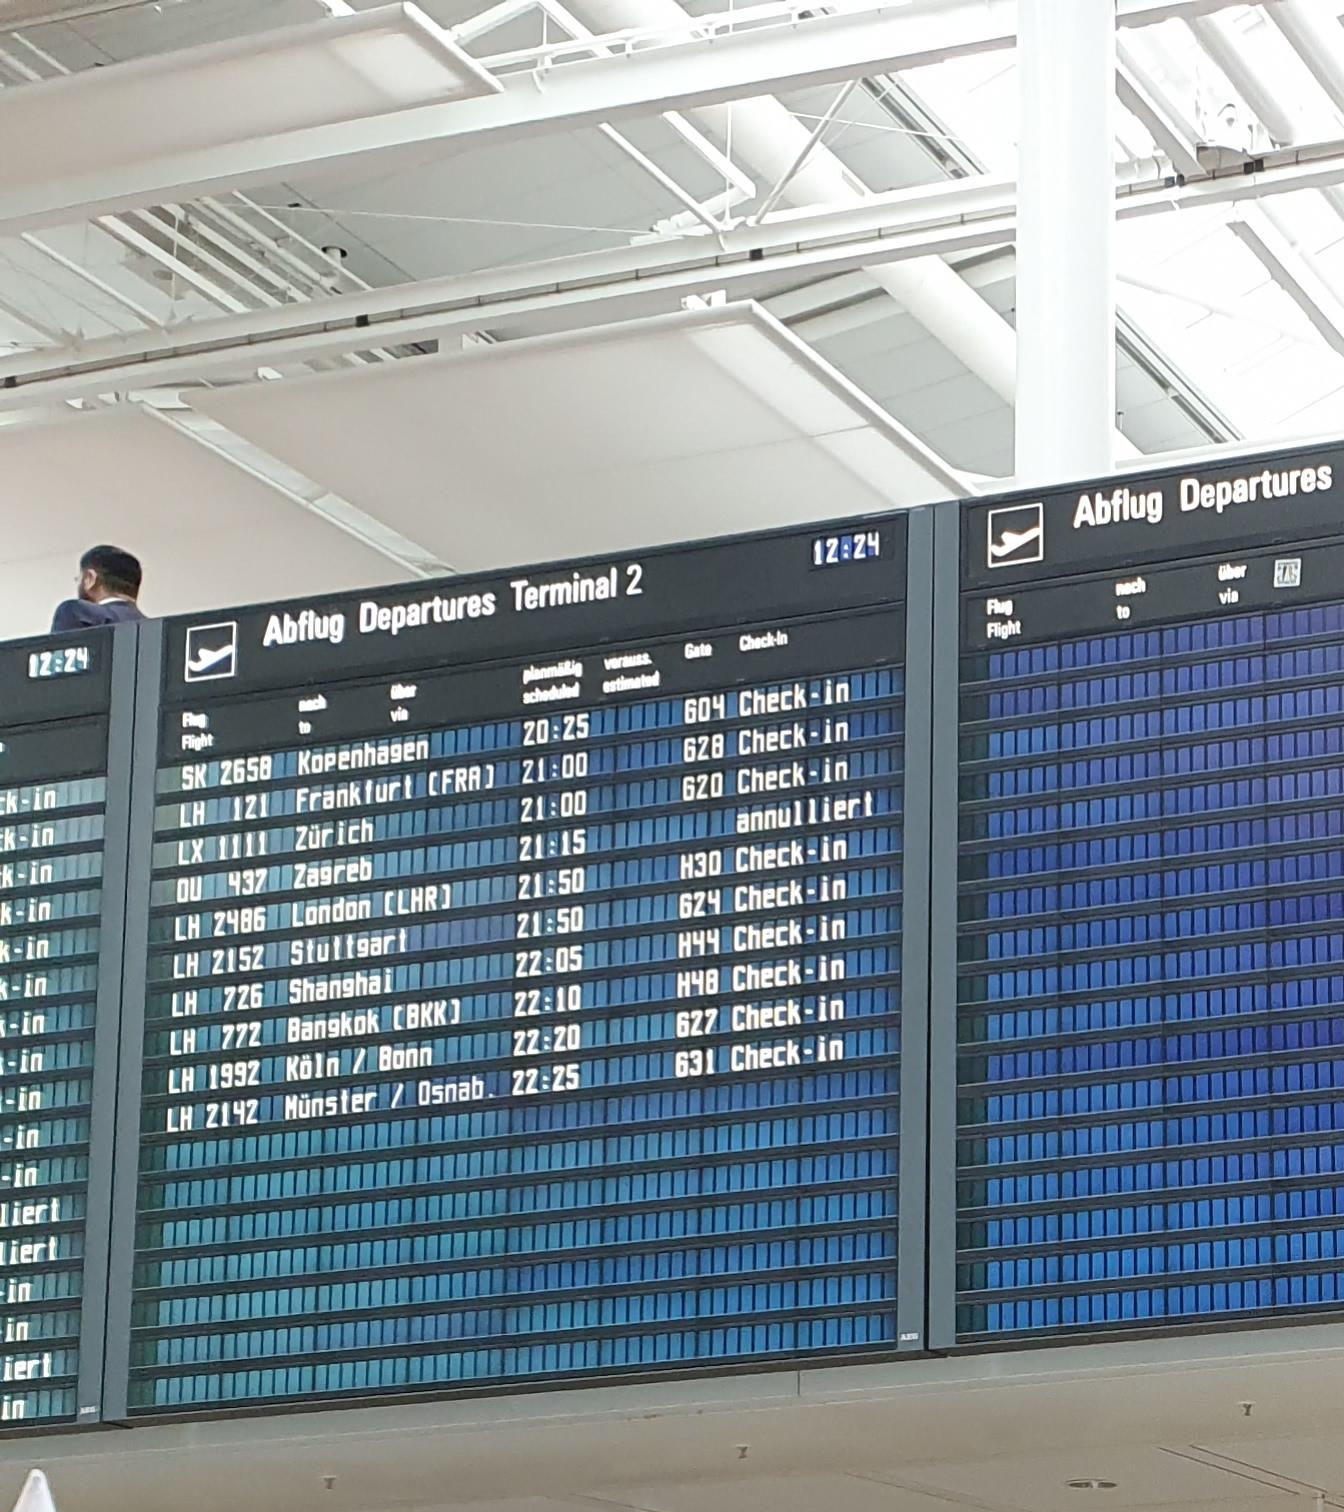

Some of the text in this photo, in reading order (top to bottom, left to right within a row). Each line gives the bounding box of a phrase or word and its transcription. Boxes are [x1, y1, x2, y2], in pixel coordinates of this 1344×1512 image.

[1074, 488, 1162, 528] Abflug
[1181, 466, 1332, 513] Departures
[815, 532, 879, 564] 12:24
[263, 564, 642, 646] Abflug Departures Terminal 2
[987, 620, 1021, 639] Flight
[29, 648, 88, 678] 12:24
[180, 802, 204, 827] LH
[234, 794, 267, 820] 121
[296, 776, 411, 812] Frankfurt
[523, 753, 587, 783] 21:00
[739, 720, 847, 754] Check-in
[182, 764, 206, 790] SK
[221, 756, 271, 785] 2658
[299, 741, 428, 775] Kopenhagen
[524, 714, 588, 745] 20:25
[740, 680, 848, 716] Check-in
[182, 733, 213, 750] Flight
[177, 792, 871, 902] OU 437 Zagreb 21:15 annulliert
[179, 839, 203, 865] LX
[220, 832, 265, 859] 1111
[296, 819, 372, 850] Zürich
[522, 791, 586, 821] 21:00
[738, 759, 847, 793] Check-in
[174, 953, 198, 978] LH
[213, 946, 263, 974] 2152
[291, 929, 405, 965] Stuttgart
[518, 907, 582, 938] 21:50
[735, 877, 845, 911] Check-in
[176, 915, 199, 940] LH
[214, 907, 265, 936] 2486
[293, 898, 370, 927] London
[519, 868, 584, 899] 21:50
[681, 851, 720, 879] H30
[736, 837, 846, 872] Check-in
[171, 1029, 195, 1055] LH
[223, 1022, 260, 1049] 772
[288, 1010, 379, 1042] Bangkok
[515, 985, 580, 1016] 22:10
[678, 969, 718, 997] H48
[733, 956, 844, 991] Check-in
[173, 916, 844, 1016] LH 726 Shanghai 22:05 H44 Check-in
[168, 1107, 192, 1132] LH
[207, 1100, 257, 1128] 2142
[286, 1090, 376, 1119] Münster
[419, 1076, 492, 1105] Osnab.
[513, 1064, 578, 1095] 22:25
[732, 1037, 842, 1071] Check-in
[169, 1068, 193, 1093] LH
[210, 1061, 259, 1089] 1992
[287, 1053, 338, 1081] Köln
[380, 1046, 431, 1071] Bonn
[514, 1025, 580, 1056] 22:20
[733, 996, 843, 1031] Check-in
